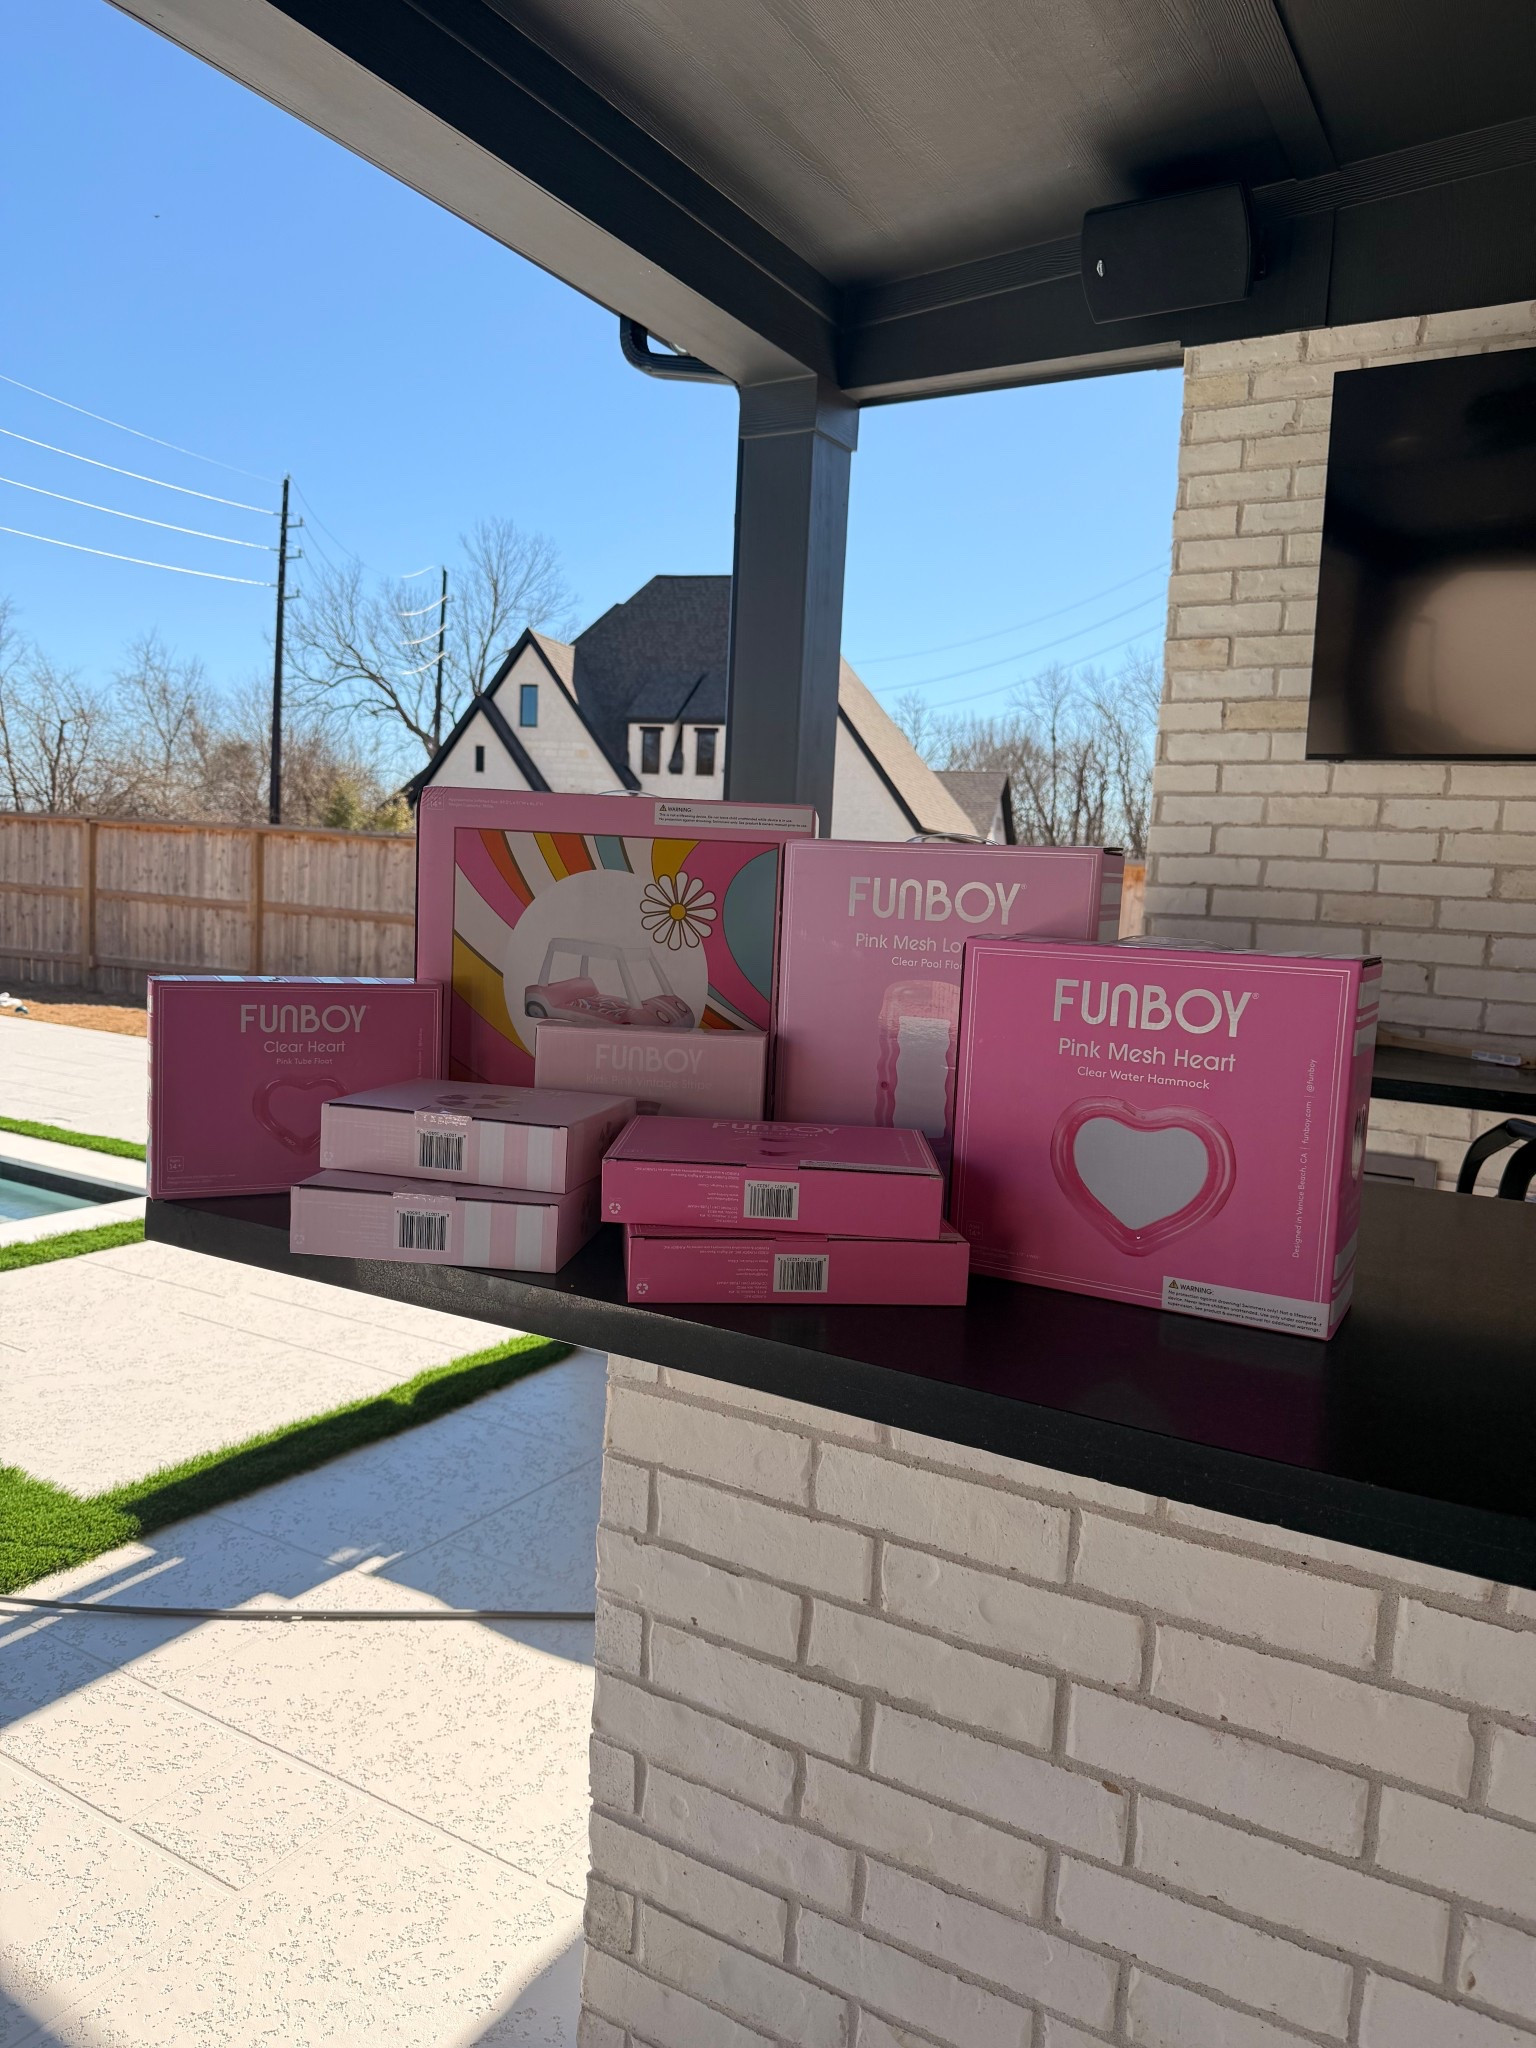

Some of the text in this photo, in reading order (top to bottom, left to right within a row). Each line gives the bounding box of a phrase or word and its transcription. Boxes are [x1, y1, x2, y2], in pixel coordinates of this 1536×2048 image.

[856, 933, 964, 953] Pink Mesh Lo
[891, 957, 918, 967] Clear
[921, 958, 942, 969] Pool
[264, 1040, 346, 1053] Clear Heart
[1058, 1037, 1236, 1073] Pink Mesh Heart
[611, 1076, 633, 1088] Pink
[635, 1077, 679, 1089] Vintage
[682, 1079, 712, 1090] Stripe
[1077, 1066, 1210, 1090] Clear Water Hammock
[1305, 1059, 1317, 1093] @funboy
[1302, 1101, 1313, 1144] funboy.com
[1299, 1152, 1309, 1164] CA
[1297, 1165, 1308, 1190] Beach,
[1295, 1191, 1305, 1215] Venice
[1294, 1216, 1303, 1224] in
[1291, 1225, 1302, 1258] Designed
[1180, 1284, 1214, 1295] WARNING:
[1218, 1299, 1241, 1307] drowning!
[1242, 1303, 1266, 1312] Swimmers
